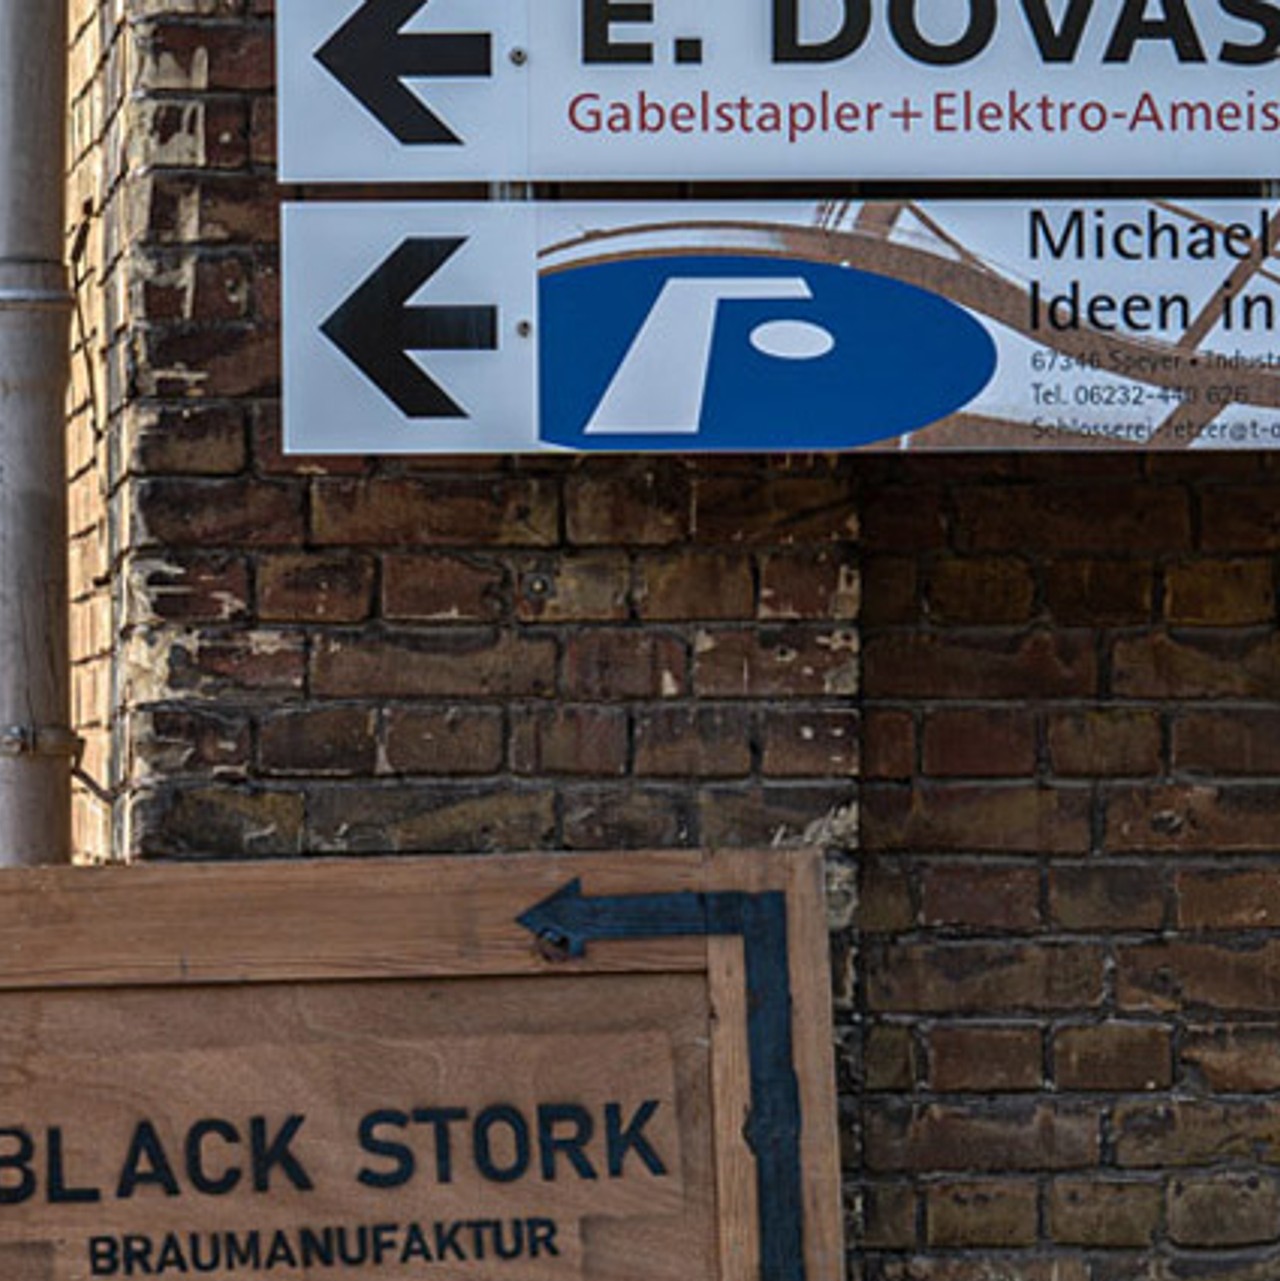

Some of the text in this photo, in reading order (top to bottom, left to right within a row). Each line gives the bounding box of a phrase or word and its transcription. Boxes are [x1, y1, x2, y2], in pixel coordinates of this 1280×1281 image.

[581, 0, 703, 65] E.
[1029, 208, 1270, 261] Michael
[1030, 280, 1190, 331] Ideen
[355, 1099, 669, 1187] STORK
[88, 1216, 561, 1278] BRAUMANUFAKTUR
